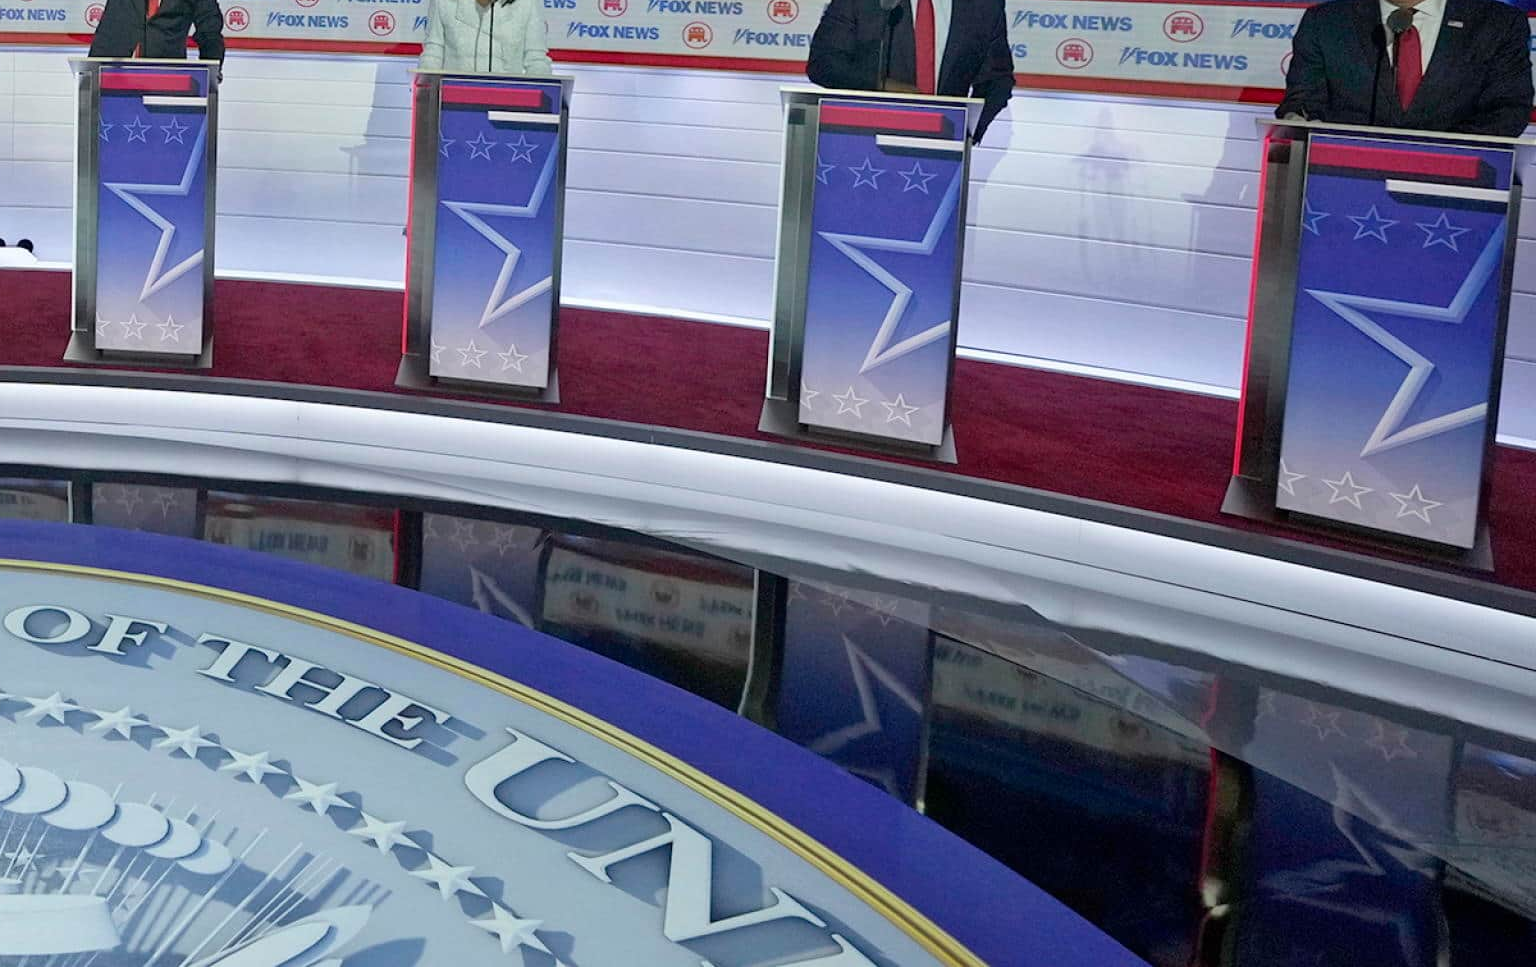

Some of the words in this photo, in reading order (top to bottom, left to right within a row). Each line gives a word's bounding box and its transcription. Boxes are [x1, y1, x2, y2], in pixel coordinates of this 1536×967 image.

[0, 8, 24, 20] FOX
[27, 9, 66, 21] NEWS
[659, 0, 691, 13] FOX
[695, 1, 742, 15] NEWS
[278, 15, 305, 27] FOX
[308, 16, 348, 28] NEWS
[1028, 13, 1068, 29] FOX
[1072, 16, 1132, 31] NEWS
[579, 25, 609, 38] FOX
[613, 26, 659, 40] NEWS
[746, 32, 779, 45] FOX
[1248, 23, 1295, 39] FOX
[1135, 50, 1178, 67] FOX
[1183, 53, 1248, 70] NEWS
[3, 605, 170, 657] OF
[196, 635, 453, 749] THE
